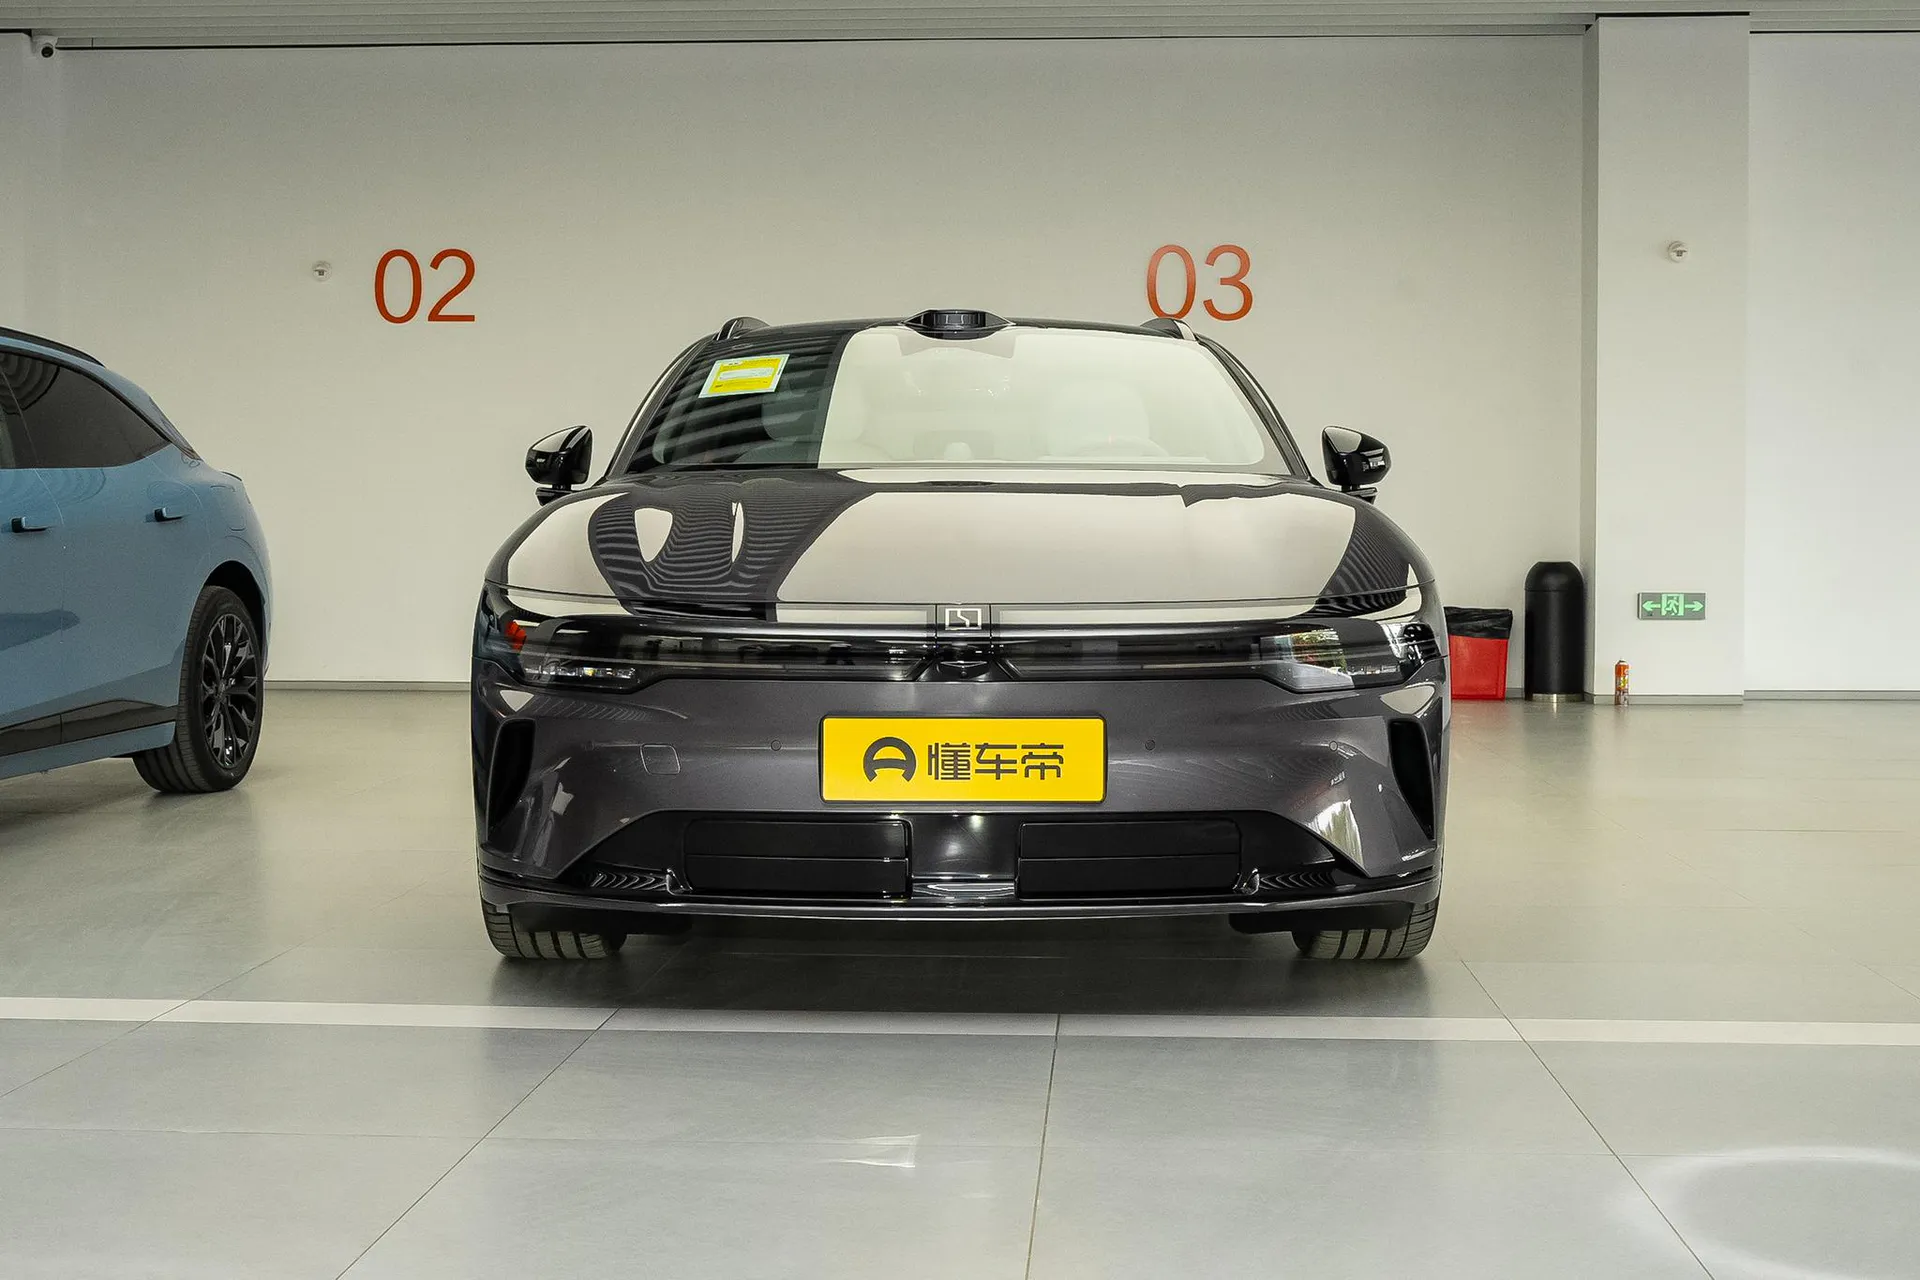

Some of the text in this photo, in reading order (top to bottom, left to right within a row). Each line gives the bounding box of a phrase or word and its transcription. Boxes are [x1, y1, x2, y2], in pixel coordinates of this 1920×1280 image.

[374, 248, 476, 324] 02
[1146, 244, 1253, 322] 03
[928, 742, 1064, 781] 懂车帝
